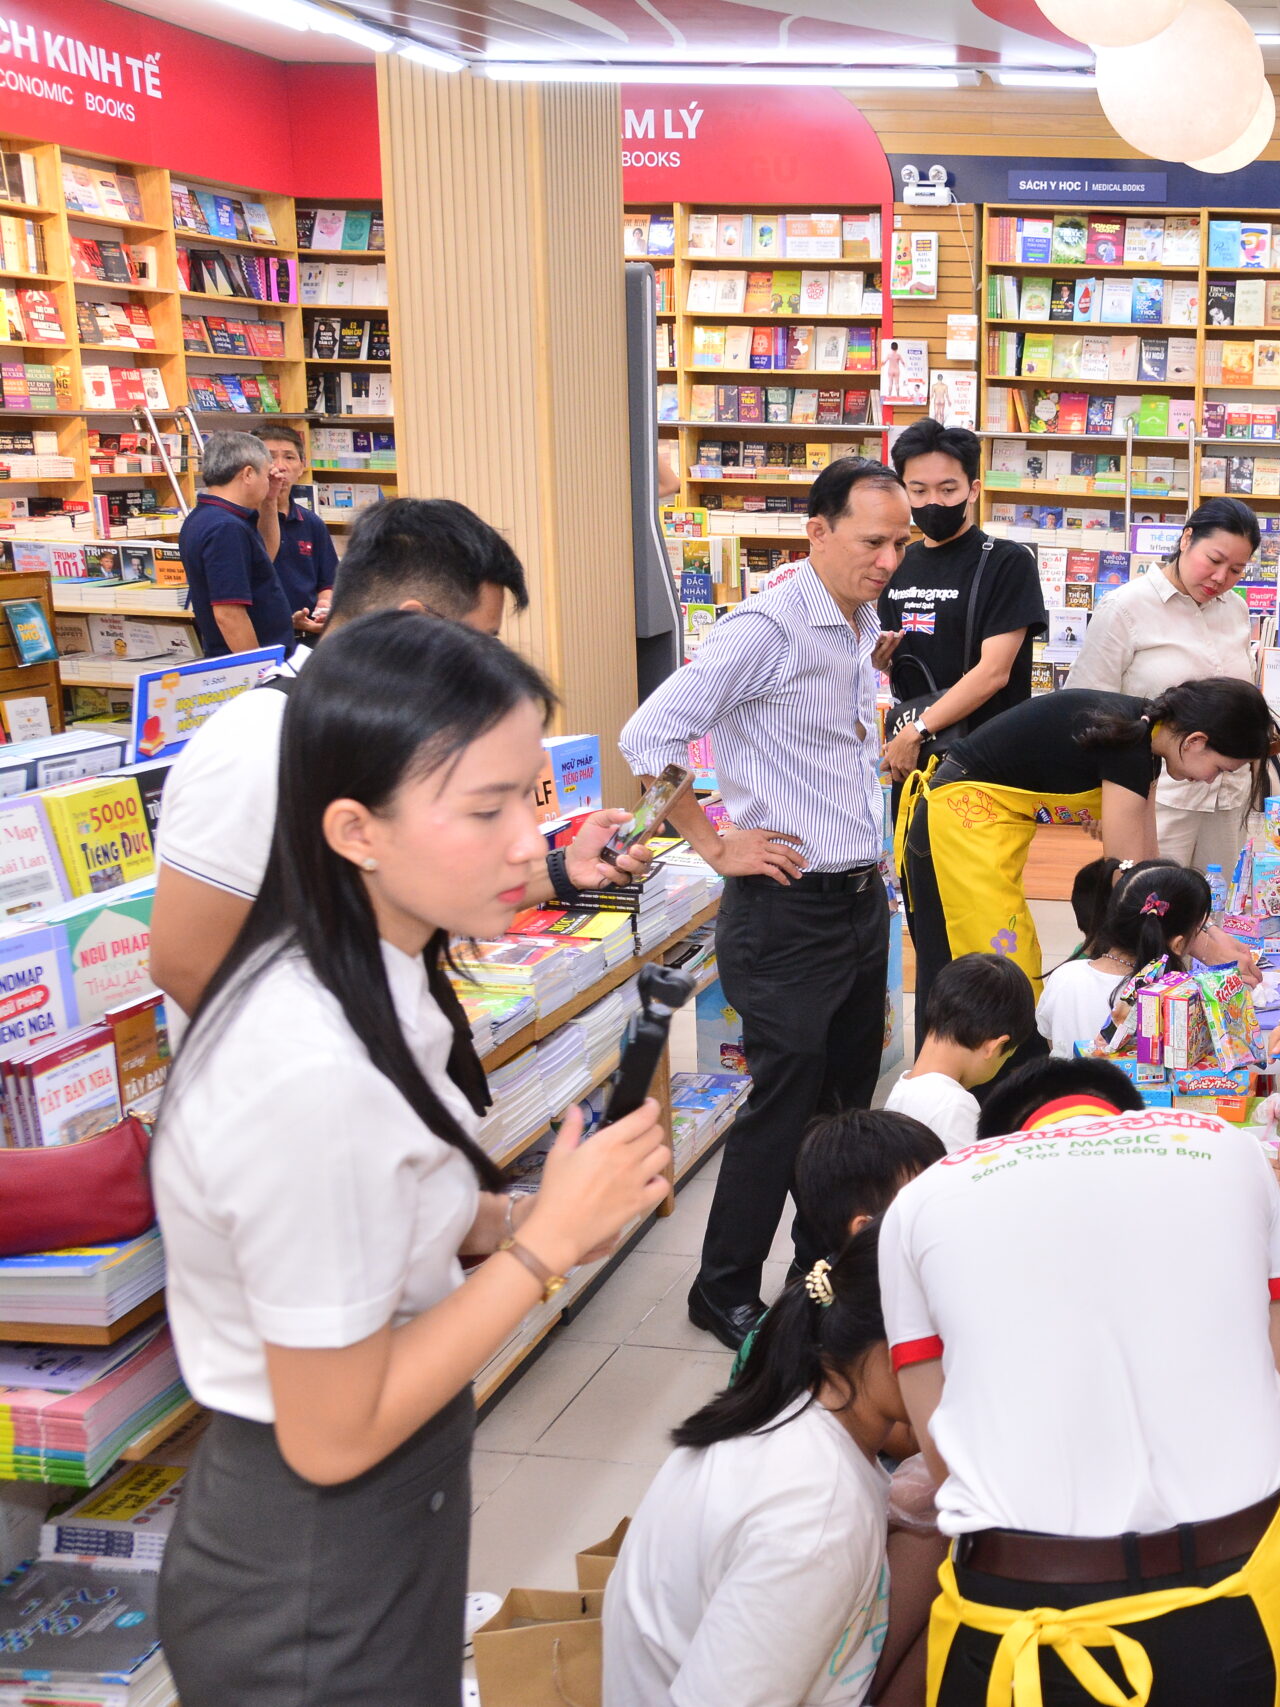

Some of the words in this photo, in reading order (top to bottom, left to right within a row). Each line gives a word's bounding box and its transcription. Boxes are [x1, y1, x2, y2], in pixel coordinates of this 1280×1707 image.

[44, 31, 122, 88] KINH
[125, 52, 162, 99] TẾ
[85, 92, 136, 122] BOOKS
[620, 109, 655, 139] M
[664, 101, 704, 139] LÝ
[1019, 179, 1047, 191] SÁCH
[1049, 181, 1057, 190] Y
[1059, 181, 1082, 192] HỌC
[1092, 183, 1121, 192] MEDICAL
[1122, 184, 1145, 192] BOOKS
[53, 551, 77, 560] TRUMP
[54, 561, 79, 577] 101
[683, 587, 707, 595] NHÂN
[686, 576, 704, 585] ĐẮC
[562, 758, 575, 772] NGỮ
[577, 754, 593, 768] PHÁP
[89, 797, 137, 833] 5000
[21, 854, 47, 870] Lan
[29, 1012, 55, 1035] NGA
[40, 1089, 61, 1115] TÂY
[64, 1078, 87, 1104] BAN
[88, 1066, 113, 1090] NHA
[1015, 1141, 1056, 1155] DIY
[1070, 1133, 1160, 1148] MAGIC
[971, 1159, 1018, 1182] Sáng
[1024, 1152, 1060, 1161] Tạo
[1067, 1147, 1105, 1158] Của
[1114, 1145, 1167, 1157] Riêng
[1176, 1147, 1212, 1161] Bạn
